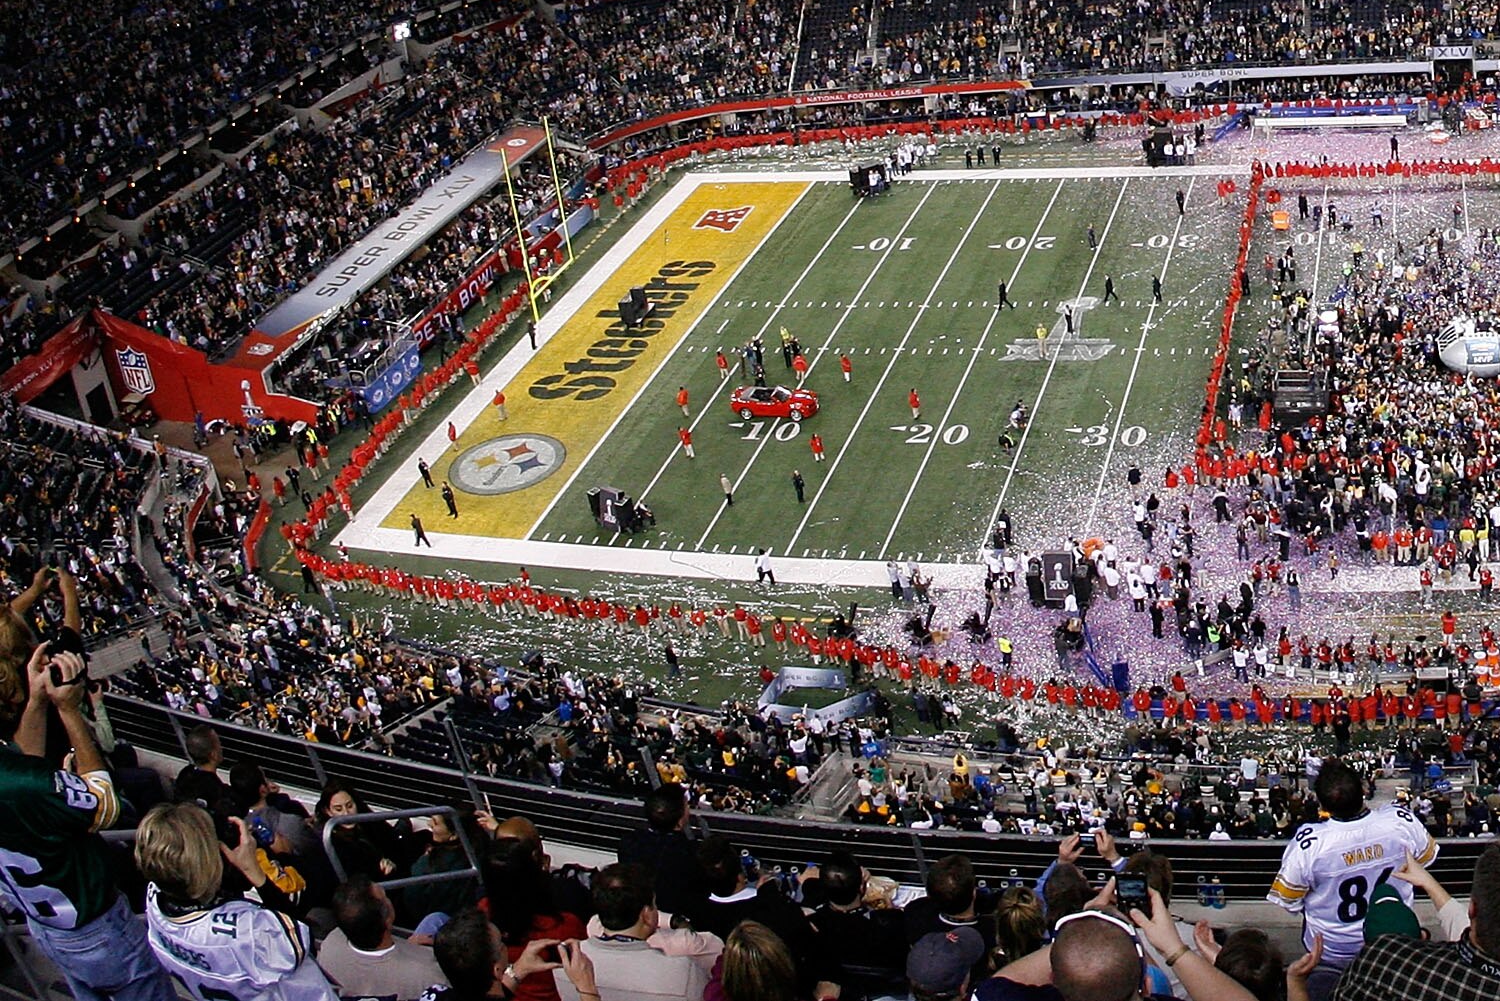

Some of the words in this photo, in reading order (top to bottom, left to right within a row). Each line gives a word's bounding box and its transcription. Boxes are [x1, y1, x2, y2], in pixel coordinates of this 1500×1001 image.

[1437, 47, 1469, 58] XLV
[1181, 70, 1215, 78] SUPER
[806, 94, 845, 103] NATIONAL
[847, 91, 889, 100] FOOTBALL
[890, 88, 922, 97] LEAGUE
[316, 244, 388, 298] SUPER
[385, 202, 446, 242] BOWL
[437, 174, 478, 200] XLV
[863, 236, 918, 251] 10
[1004, 236, 1057, 250] 20
[124, 366, 150, 390] NFL
[741, 421, 800, 442] 10
[904, 424, 970, 445] 20
[1082, 425, 1148, 447] 30
[1049, 581, 1070, 590] XLV
[1295, 826, 1319, 851] 86
[1341, 843, 1385, 867] WARD
[211, 910, 238, 940] 12
